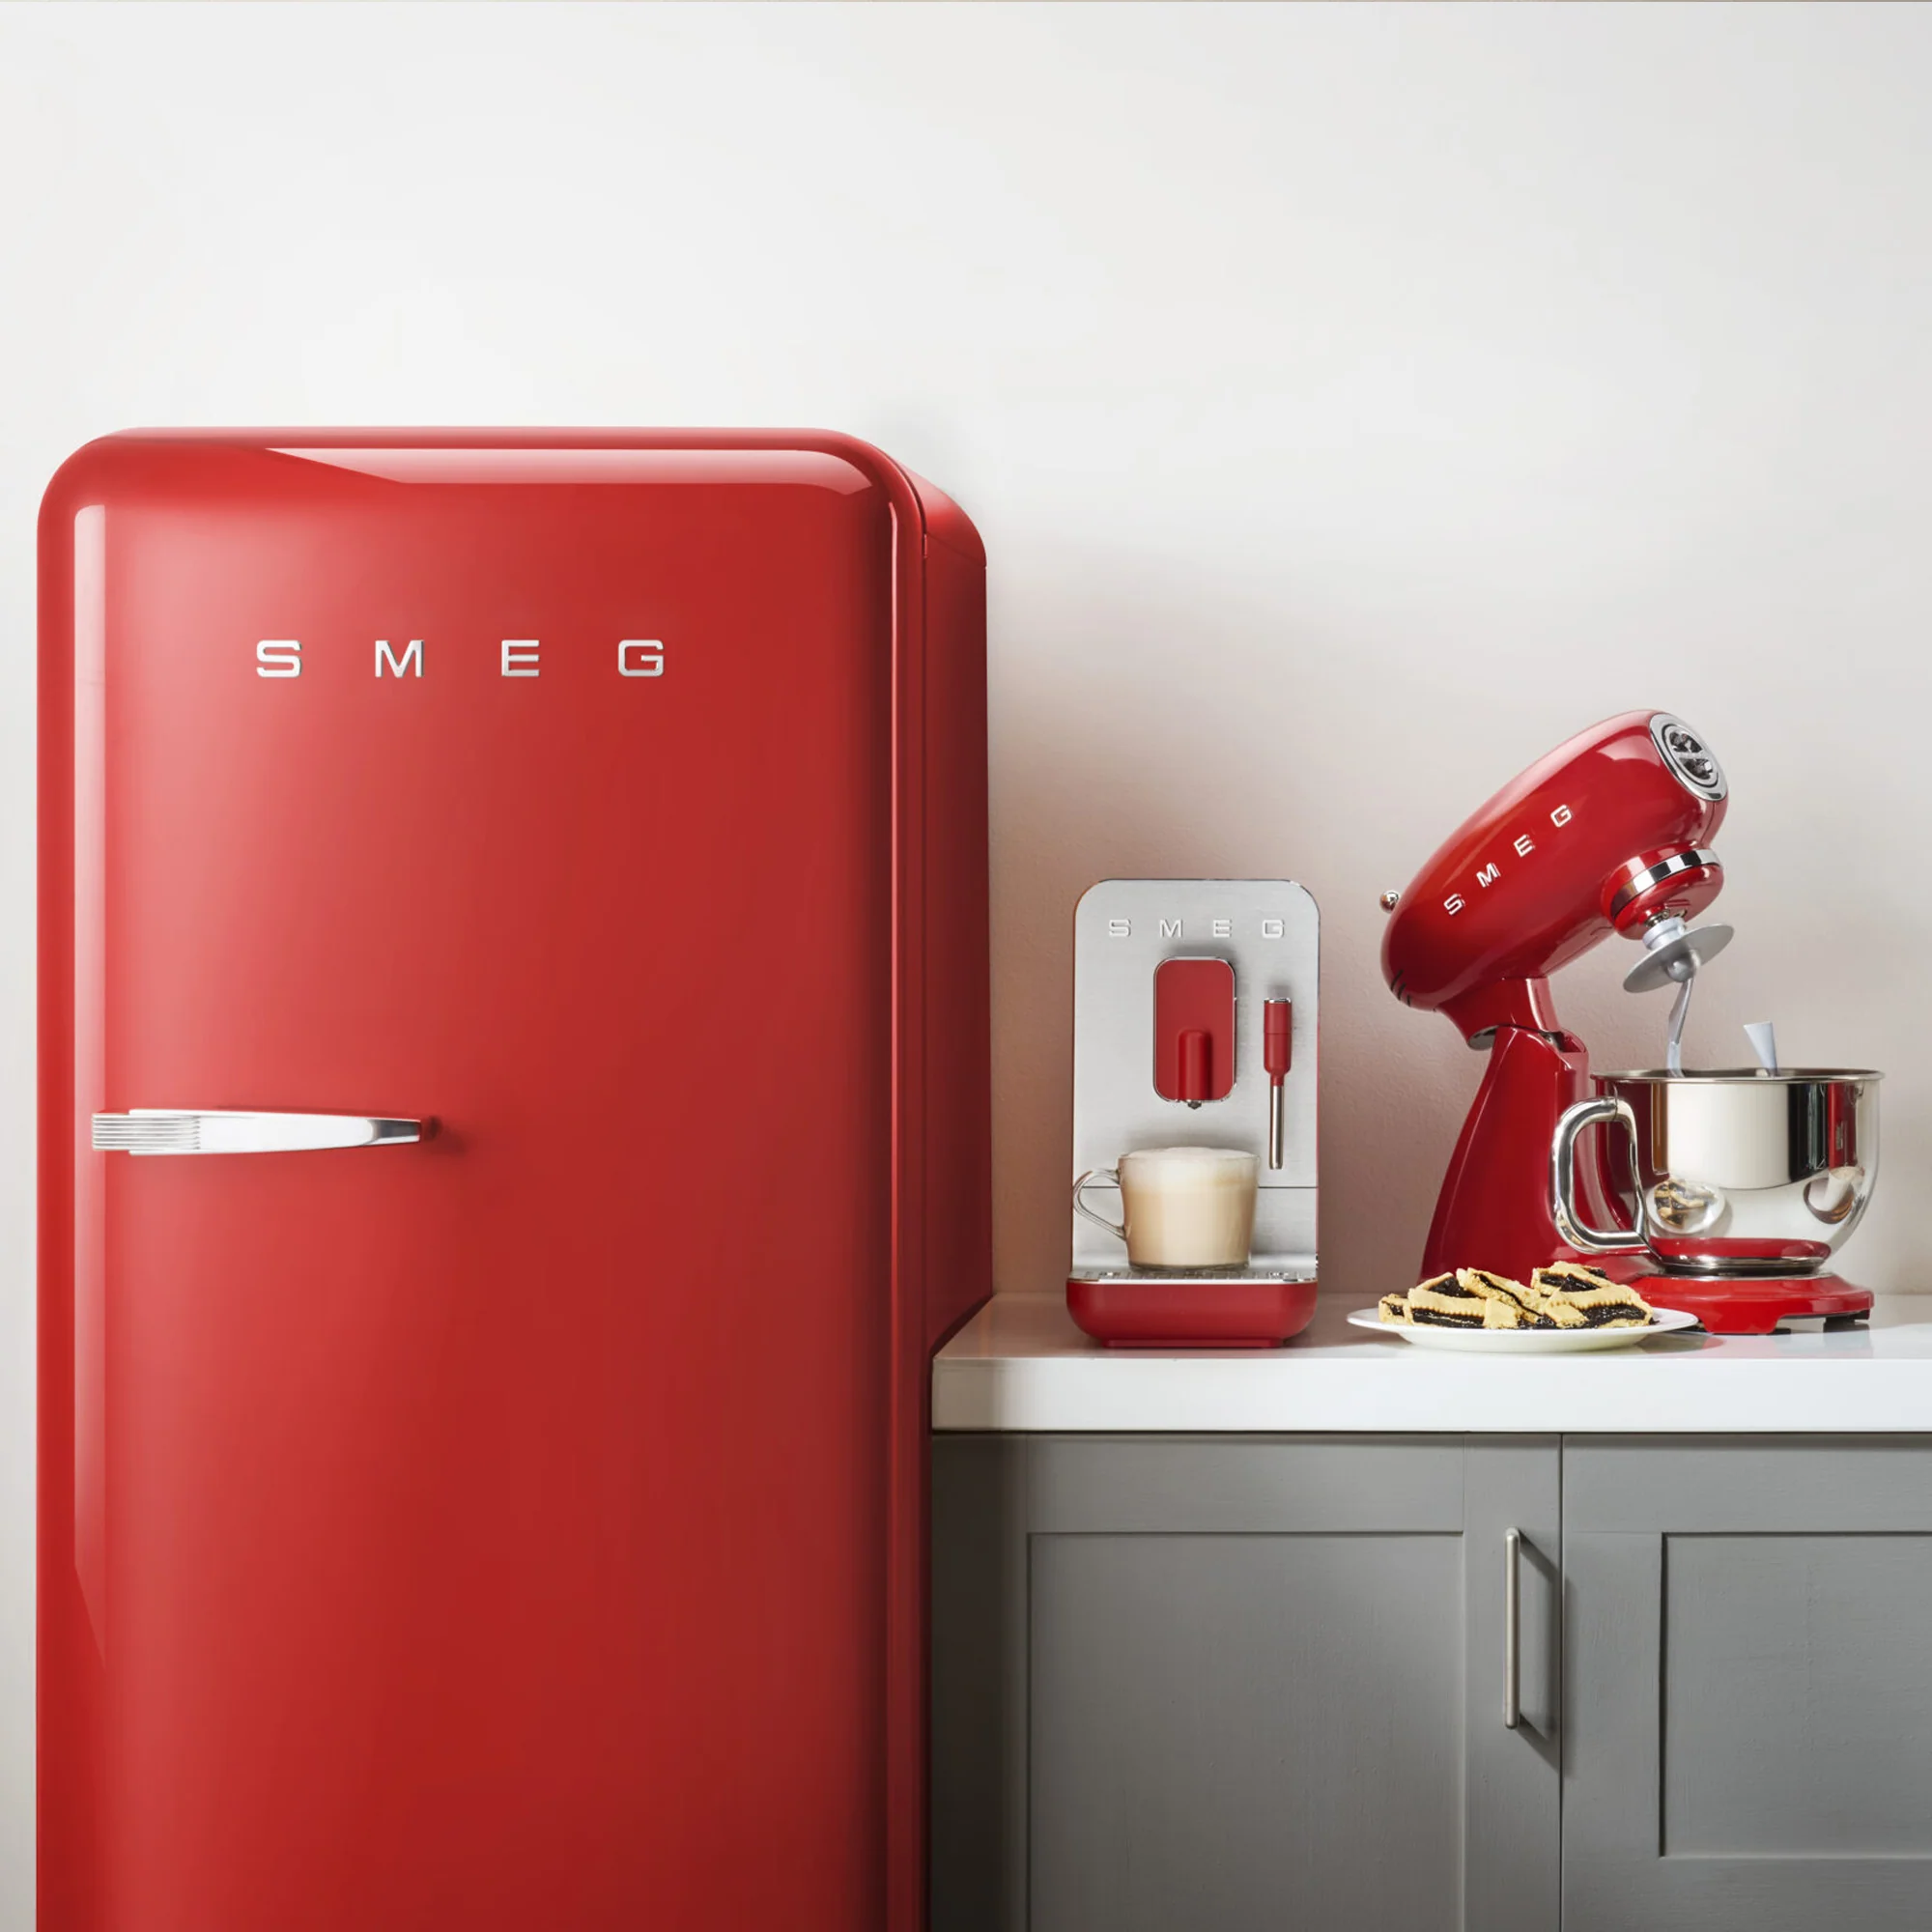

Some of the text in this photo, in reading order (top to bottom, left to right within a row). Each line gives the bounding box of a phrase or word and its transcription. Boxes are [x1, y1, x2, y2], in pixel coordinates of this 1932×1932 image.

[256, 639, 665, 678] SMEG
[1443, 805, 1573, 915] SMEG
[1109, 919, 1285, 939] SMEG
